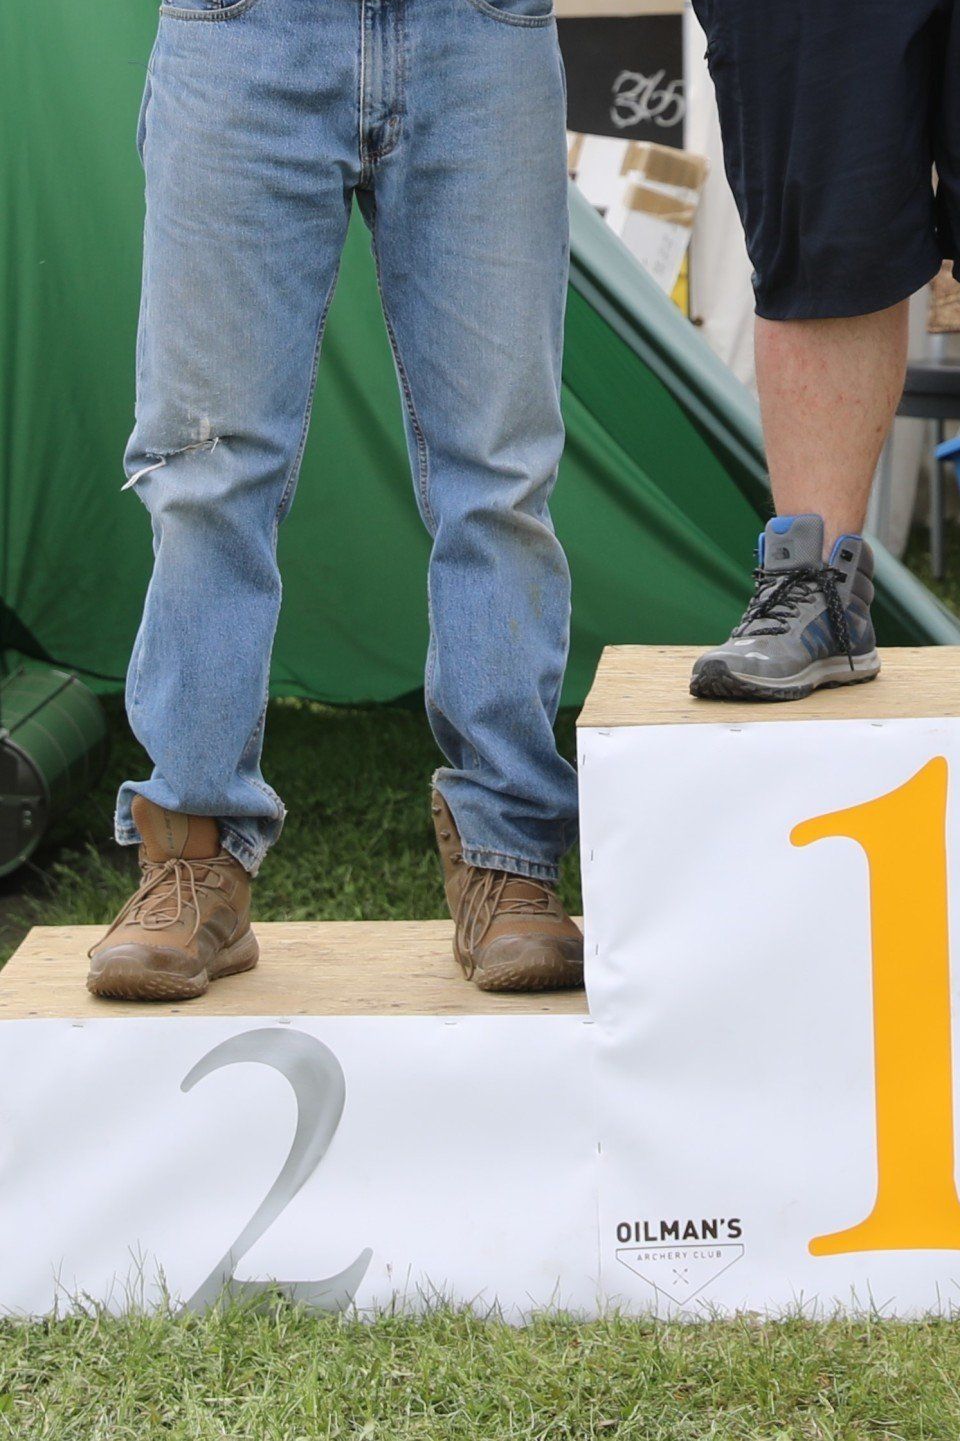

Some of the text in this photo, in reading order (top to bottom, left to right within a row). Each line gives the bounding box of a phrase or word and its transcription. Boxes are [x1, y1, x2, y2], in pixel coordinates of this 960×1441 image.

[179, 1026, 374, 1318] 2
[616, 1217, 743, 1243] OILMAN'S
[637, 1250, 722, 1261] ARCHERY CLUB
